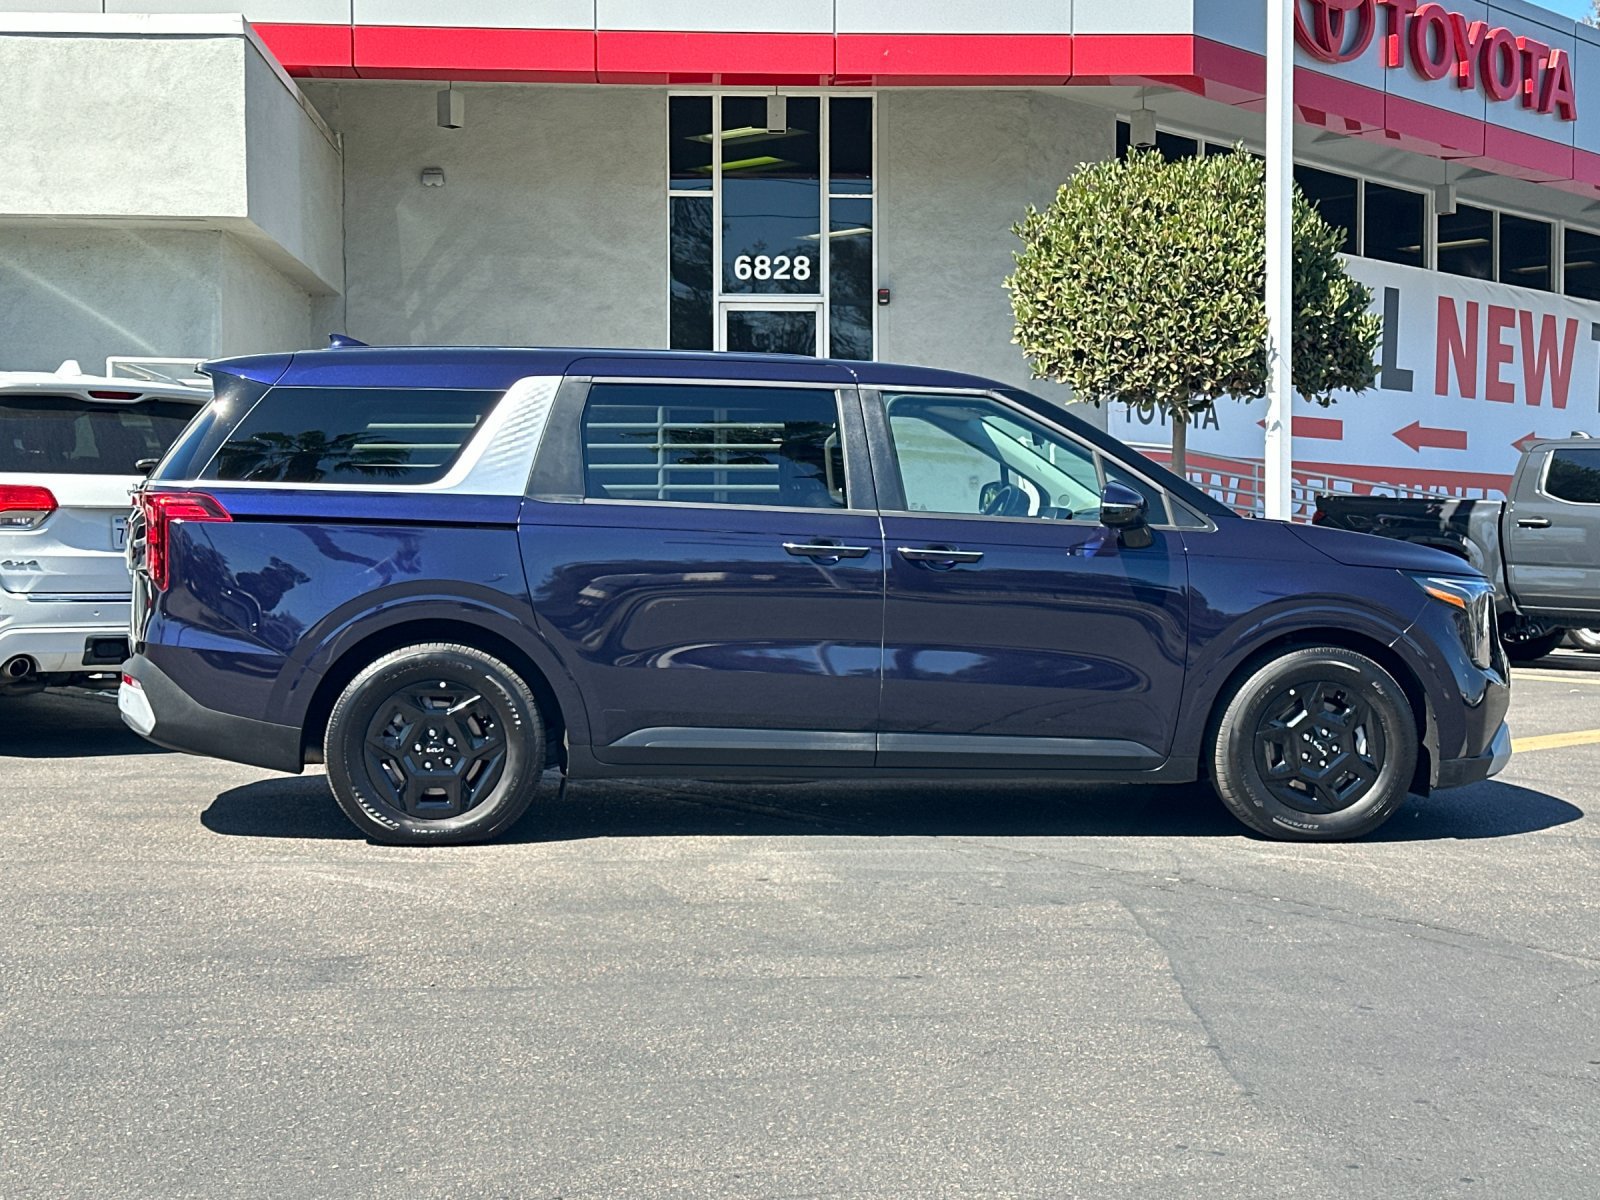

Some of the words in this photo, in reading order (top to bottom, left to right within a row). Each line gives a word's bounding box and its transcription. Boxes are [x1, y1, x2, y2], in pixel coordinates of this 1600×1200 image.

[1375, 0, 1577, 121] TOYOTA
[734, 255, 811, 280] 6828
[1434, 295, 1579, 410] NEW
[1122, 399, 1220, 431] TOYTA
